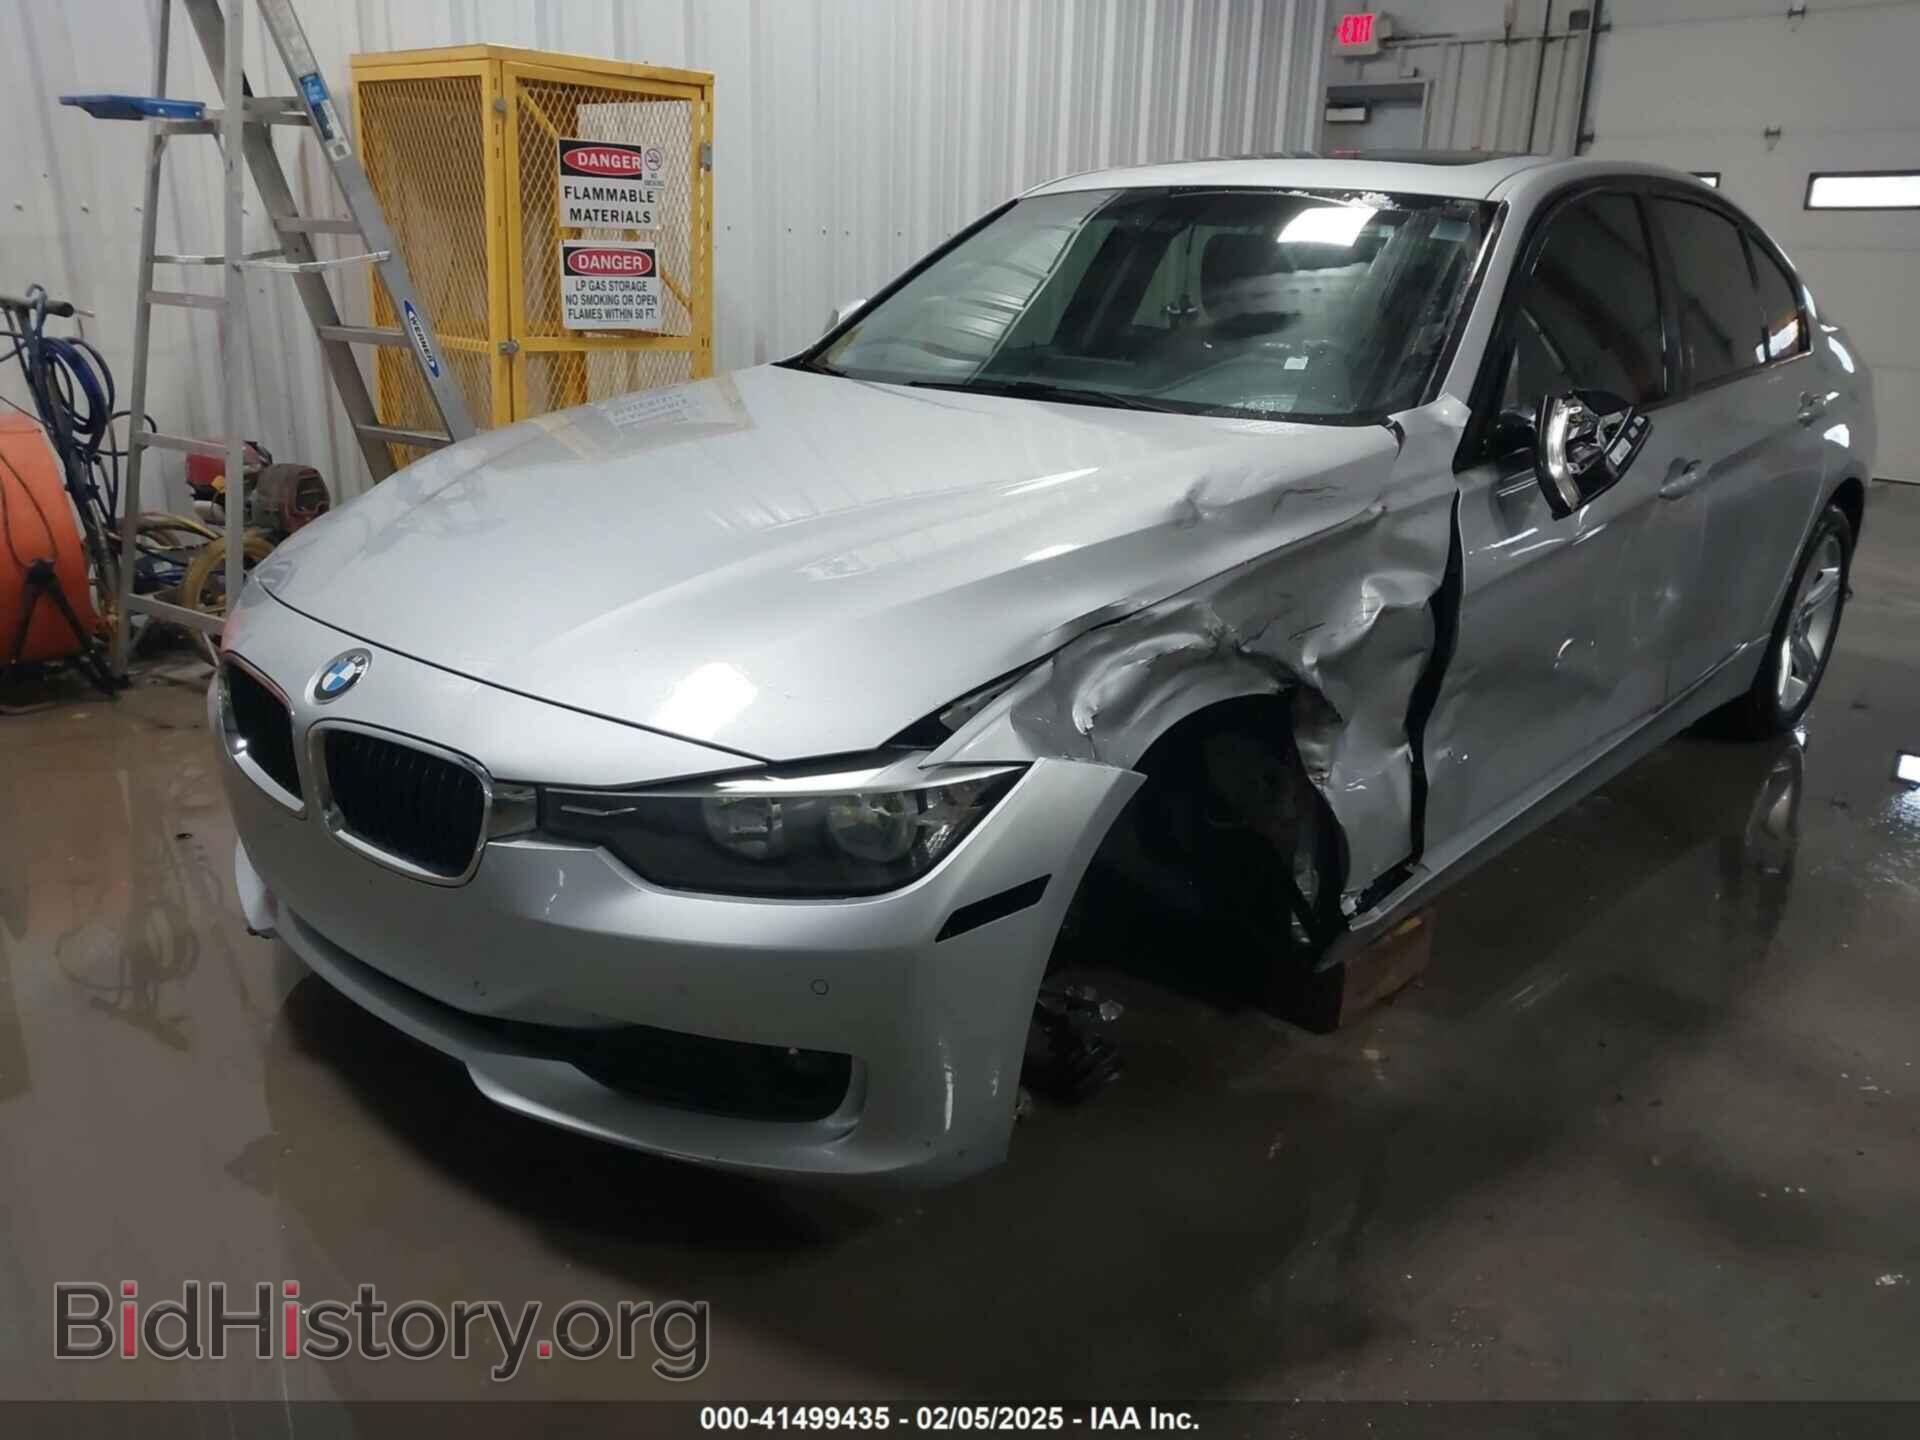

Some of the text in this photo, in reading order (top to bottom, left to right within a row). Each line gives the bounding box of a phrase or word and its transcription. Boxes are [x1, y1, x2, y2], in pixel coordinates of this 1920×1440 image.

[1341, 14, 1374, 43] EXIT
[577, 152, 640, 169] DANGER
[564, 186, 655, 203] FLAMMABLE
[569, 208, 652, 223] MATERIALS
[578, 255, 643, 270] DANGER
[575, 280, 648, 292] LP GAS STORAGE
[565, 294, 658, 306] NO SMOKING OR OPEN
[567, 308, 602, 319] FLAMES
[602, 308, 633, 319] WITHIN
[634, 308, 644, 319] 50
[409, 315, 434, 362] WERNER
